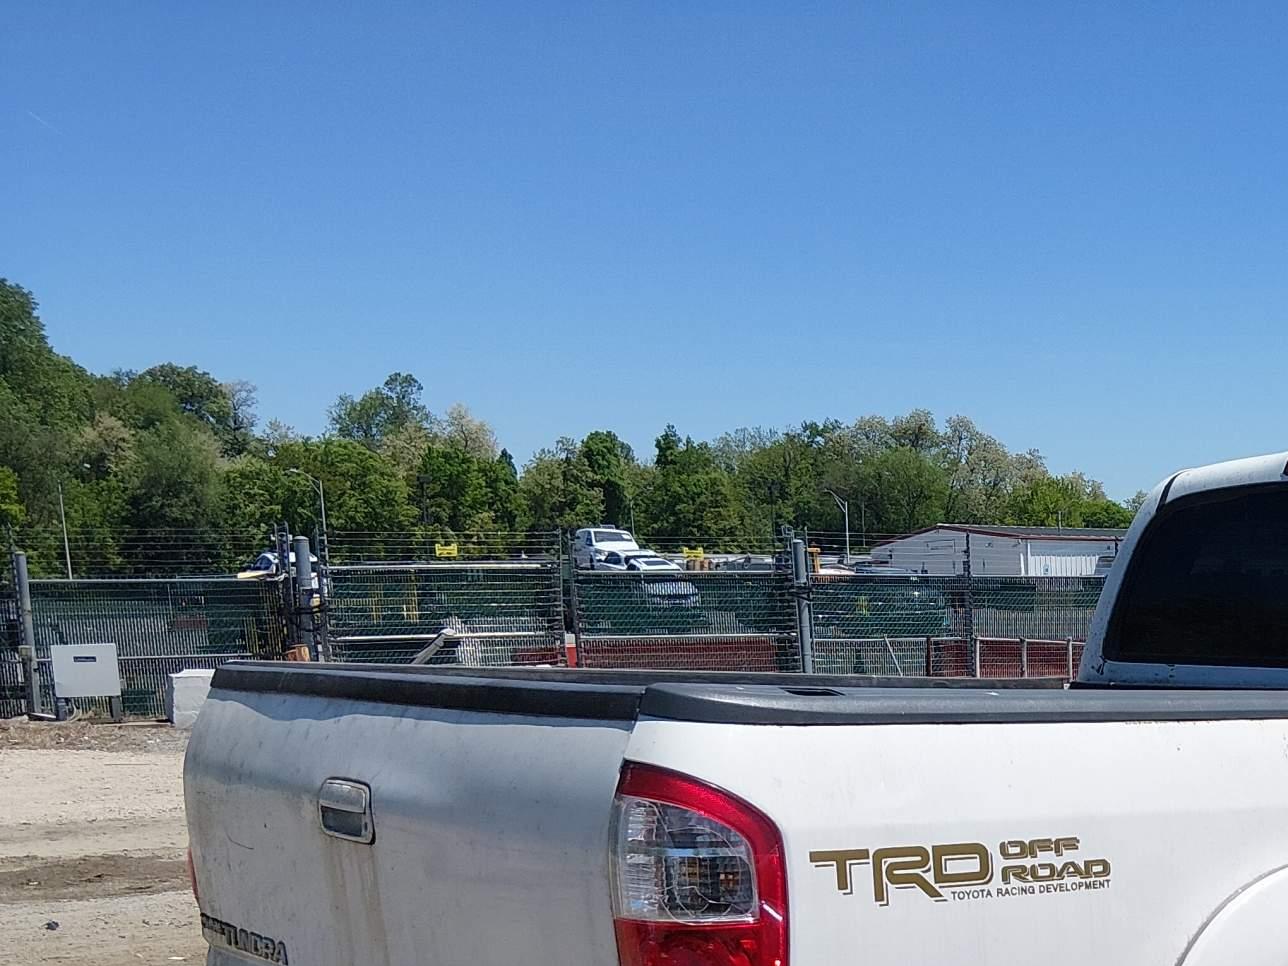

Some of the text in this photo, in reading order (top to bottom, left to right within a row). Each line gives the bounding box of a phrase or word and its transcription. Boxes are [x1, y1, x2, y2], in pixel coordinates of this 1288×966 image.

[809, 836, 1080, 906] TRD OFF
[1000, 858, 1111, 885] ROAD
[951, 879, 1111, 901] TOYOTA RACING DEVELOPMENT
[223, 922, 288, 966] TUNDRA
